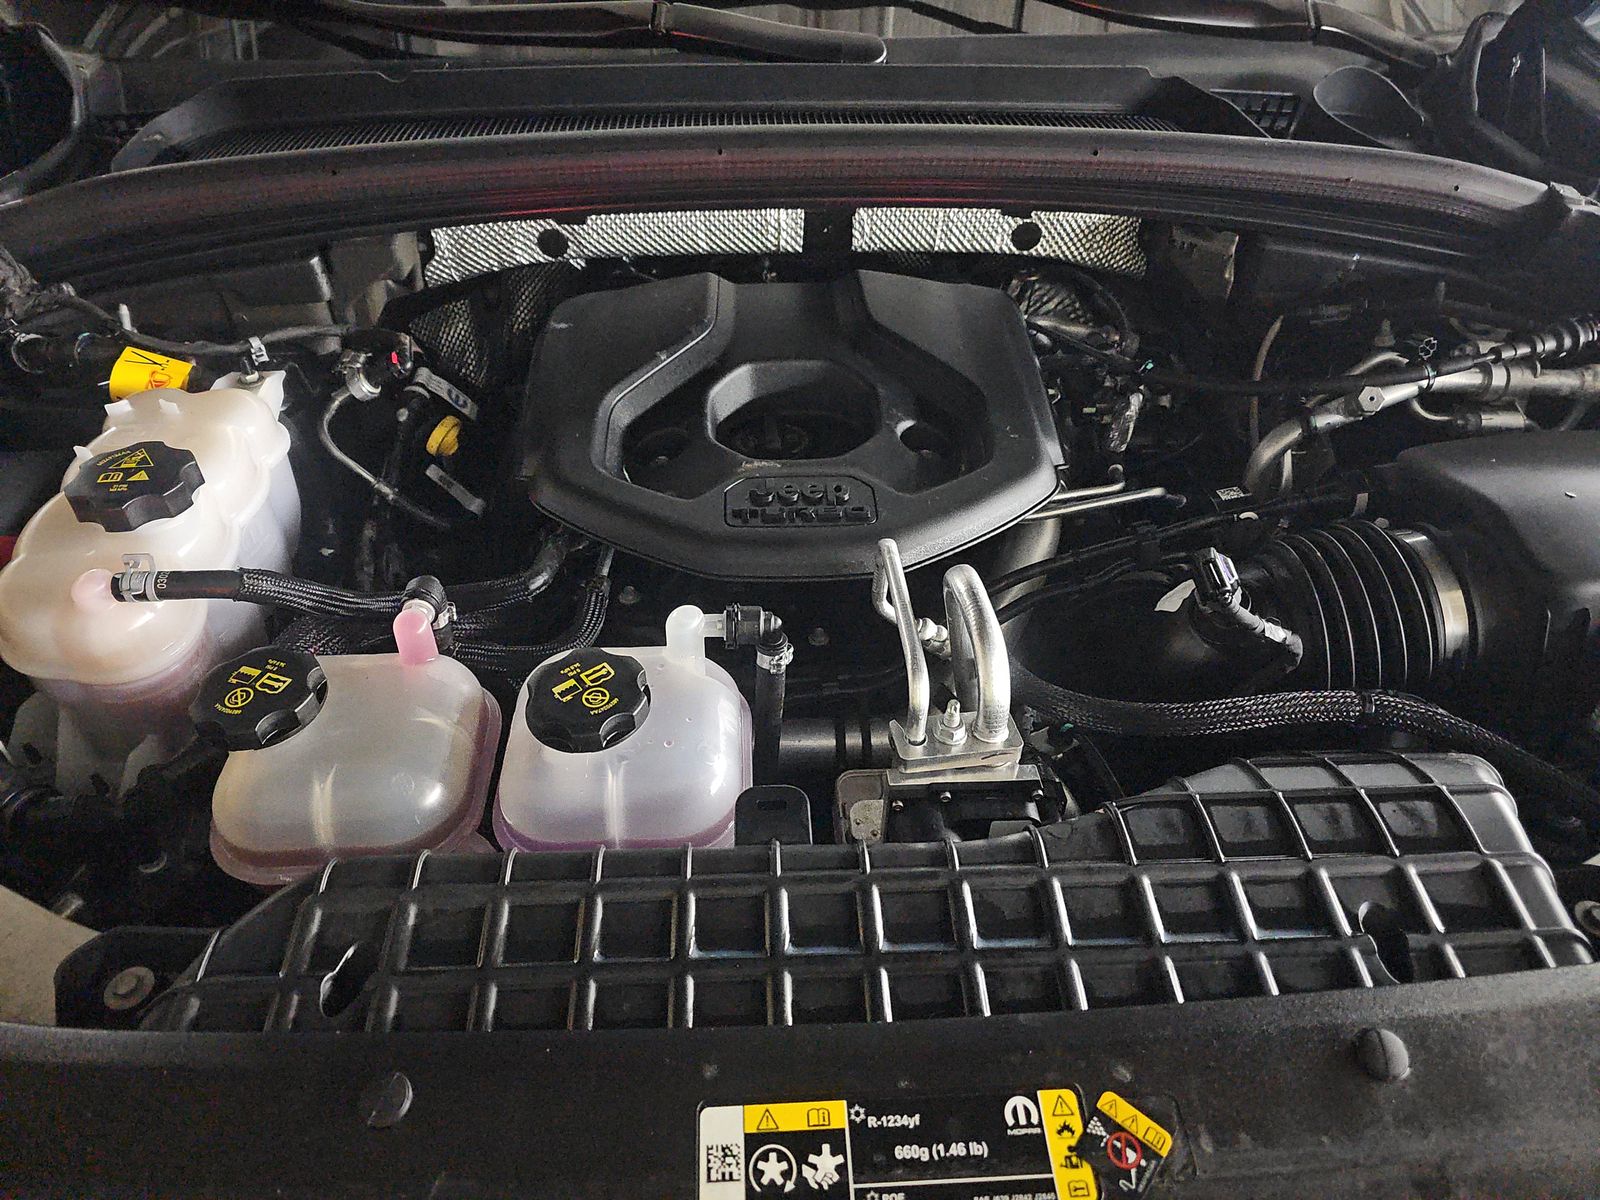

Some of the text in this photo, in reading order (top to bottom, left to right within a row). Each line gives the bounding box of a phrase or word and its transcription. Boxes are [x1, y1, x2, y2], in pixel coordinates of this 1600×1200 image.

[867, 1113, 920, 1129] R-1234yf
[894, 1141, 989, 1161] 660g (1.46 lb)
